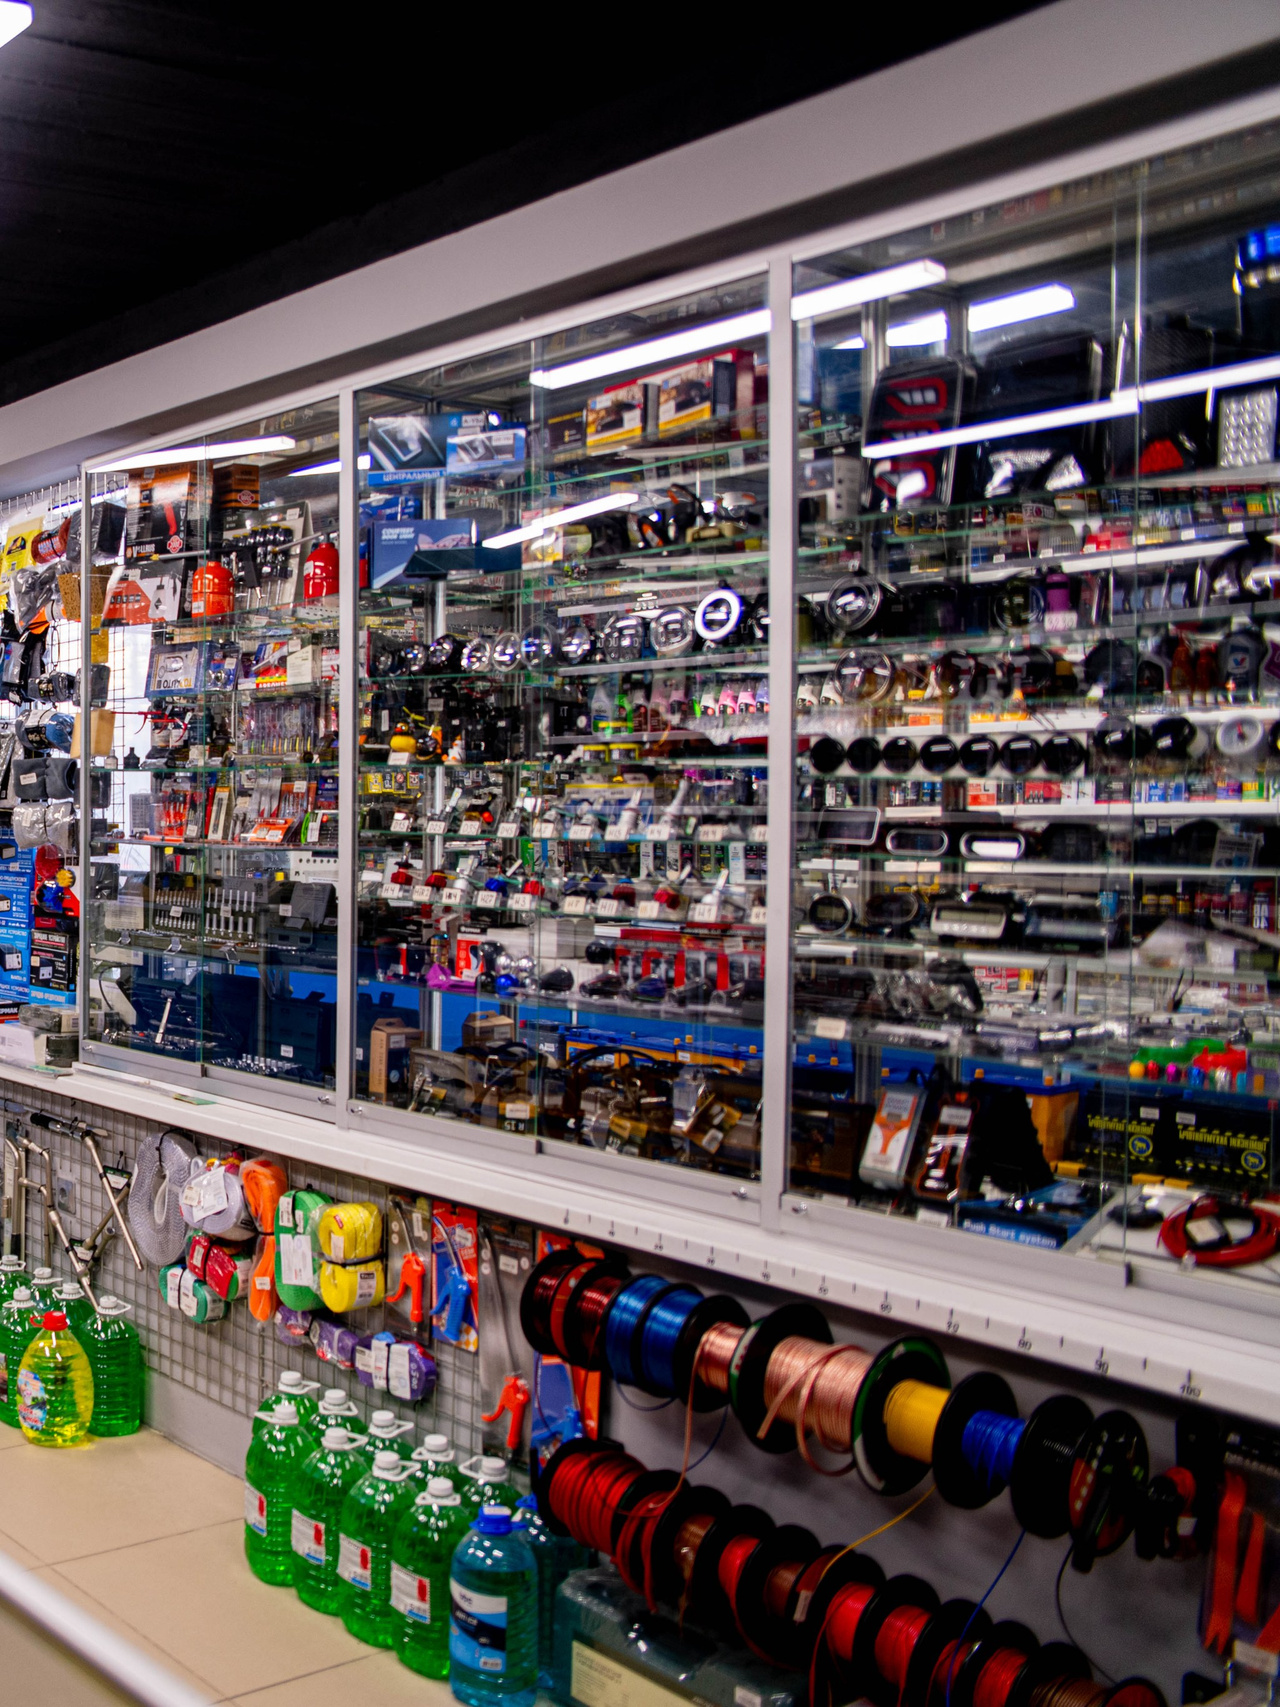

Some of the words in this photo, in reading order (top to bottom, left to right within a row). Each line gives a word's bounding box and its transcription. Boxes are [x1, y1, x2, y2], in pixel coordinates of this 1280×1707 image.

[963, 1219, 986, 1233] Push
[989, 1223, 1016, 1239] Start
[1019, 1231, 1057, 1248] system
[946, 1321, 960, 1333] 70
[1018, 1338, 1032, 1351] 80
[1094, 1359, 1109, 1375] 90
[1180, 1383, 1201, 1398] 100
